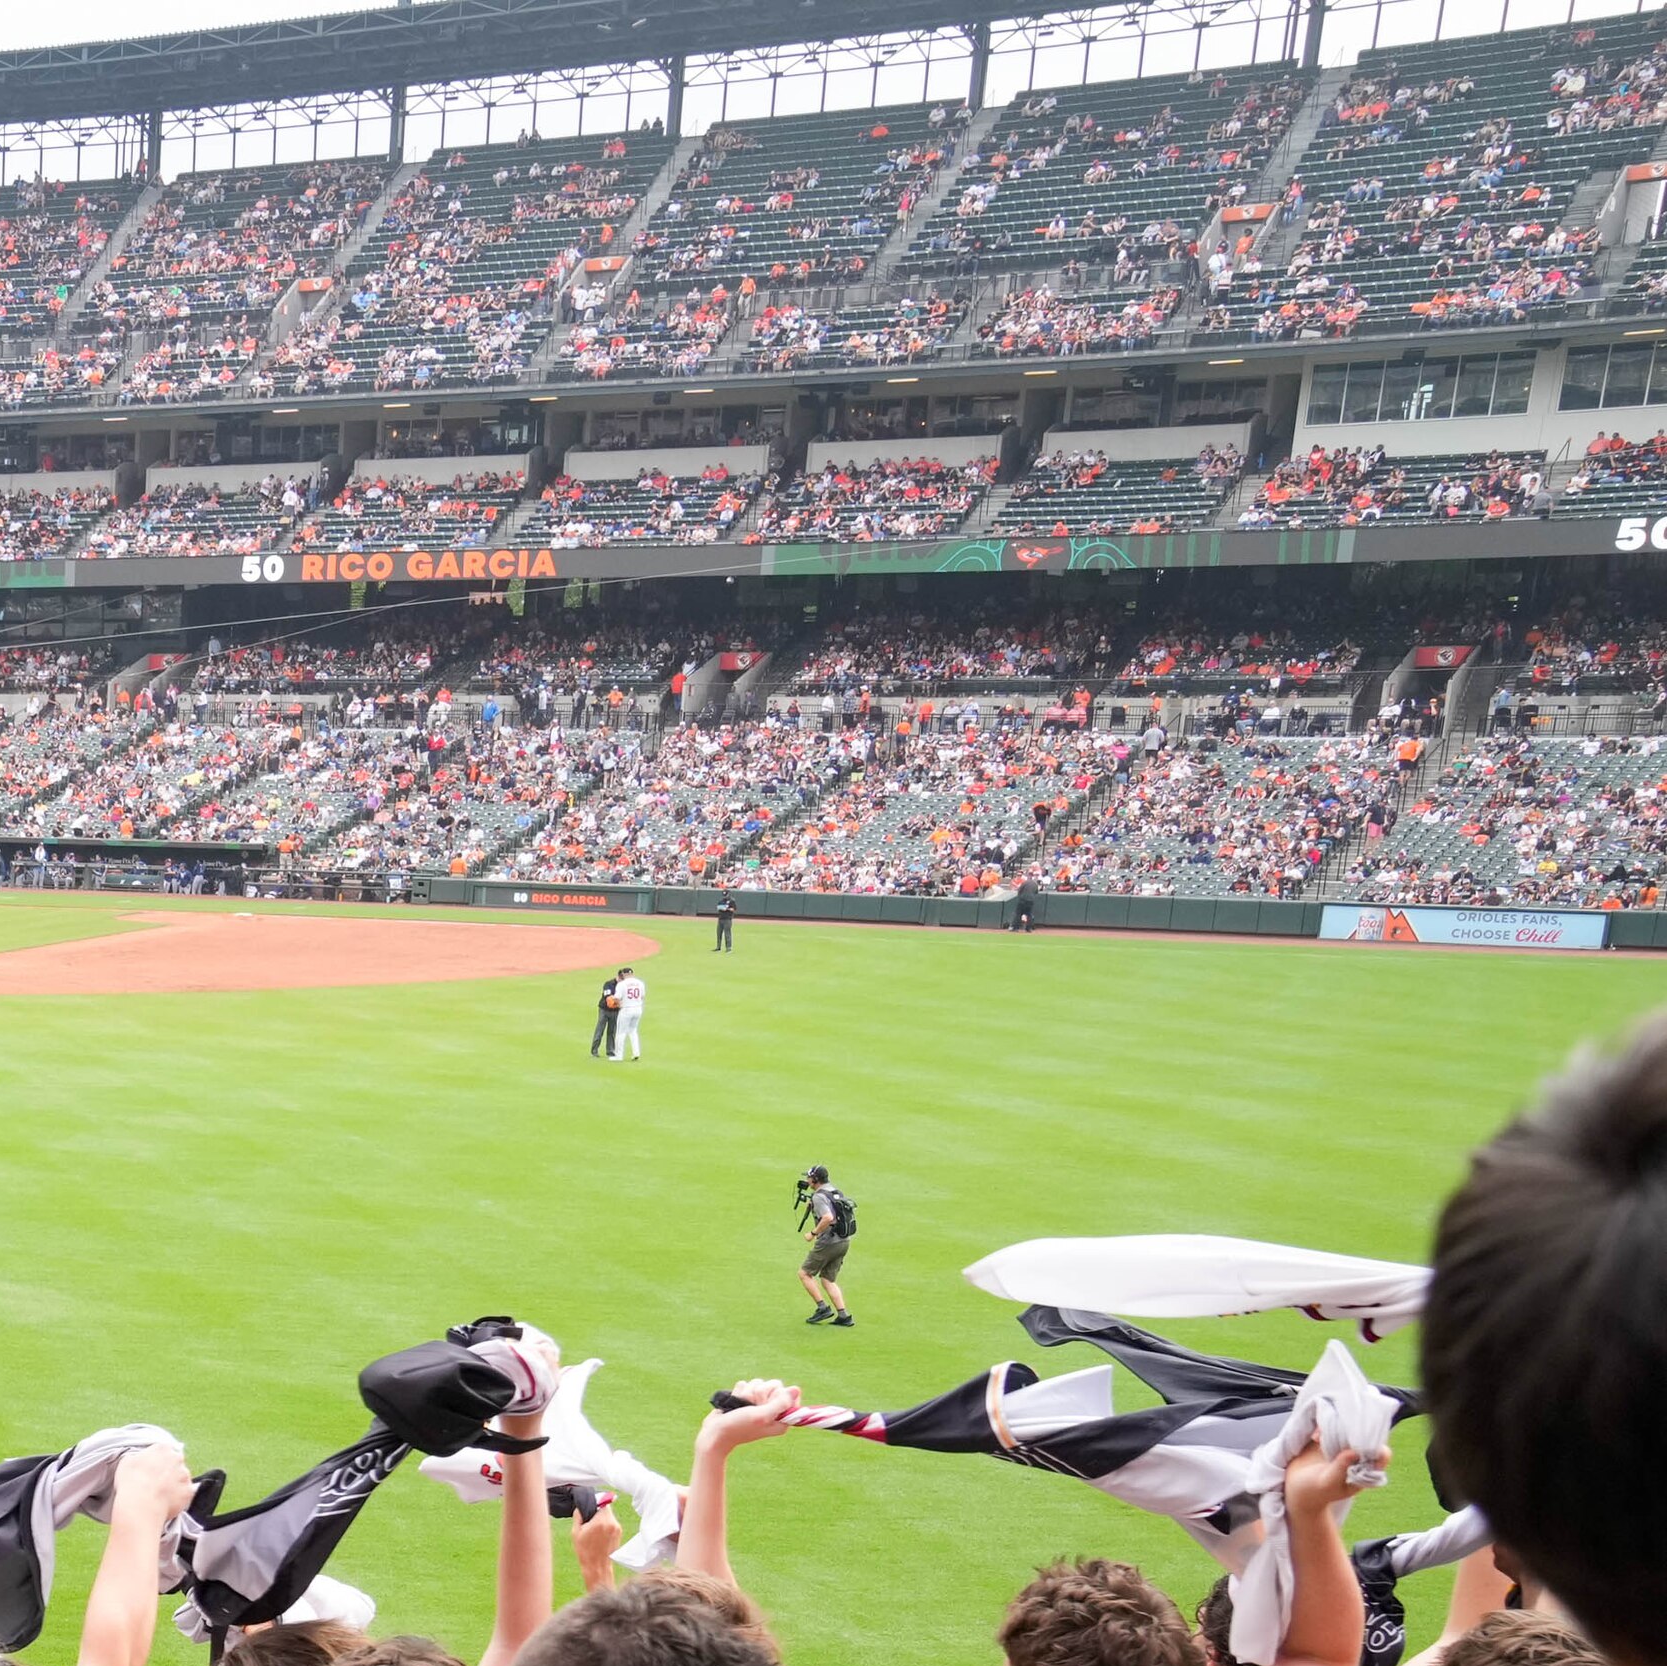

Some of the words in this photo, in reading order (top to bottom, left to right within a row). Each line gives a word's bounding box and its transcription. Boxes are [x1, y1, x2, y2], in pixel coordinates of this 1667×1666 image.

[241, 554, 284, 582] 50
[301, 552, 394, 581] RICO
[406, 550, 557, 579] GARCIA
[513, 892, 528, 903] 50
[531, 893, 560, 904] RICO
[562, 894, 606, 906] GARCIA
[1456, 912, 1517, 924] ORIOLES
[1522, 914, 1563, 927] FANS,
[1451, 928, 1510, 940] CHOOSE
[1515, 928, 1563, 944] Chill
[627, 987, 640, 1000] 50
